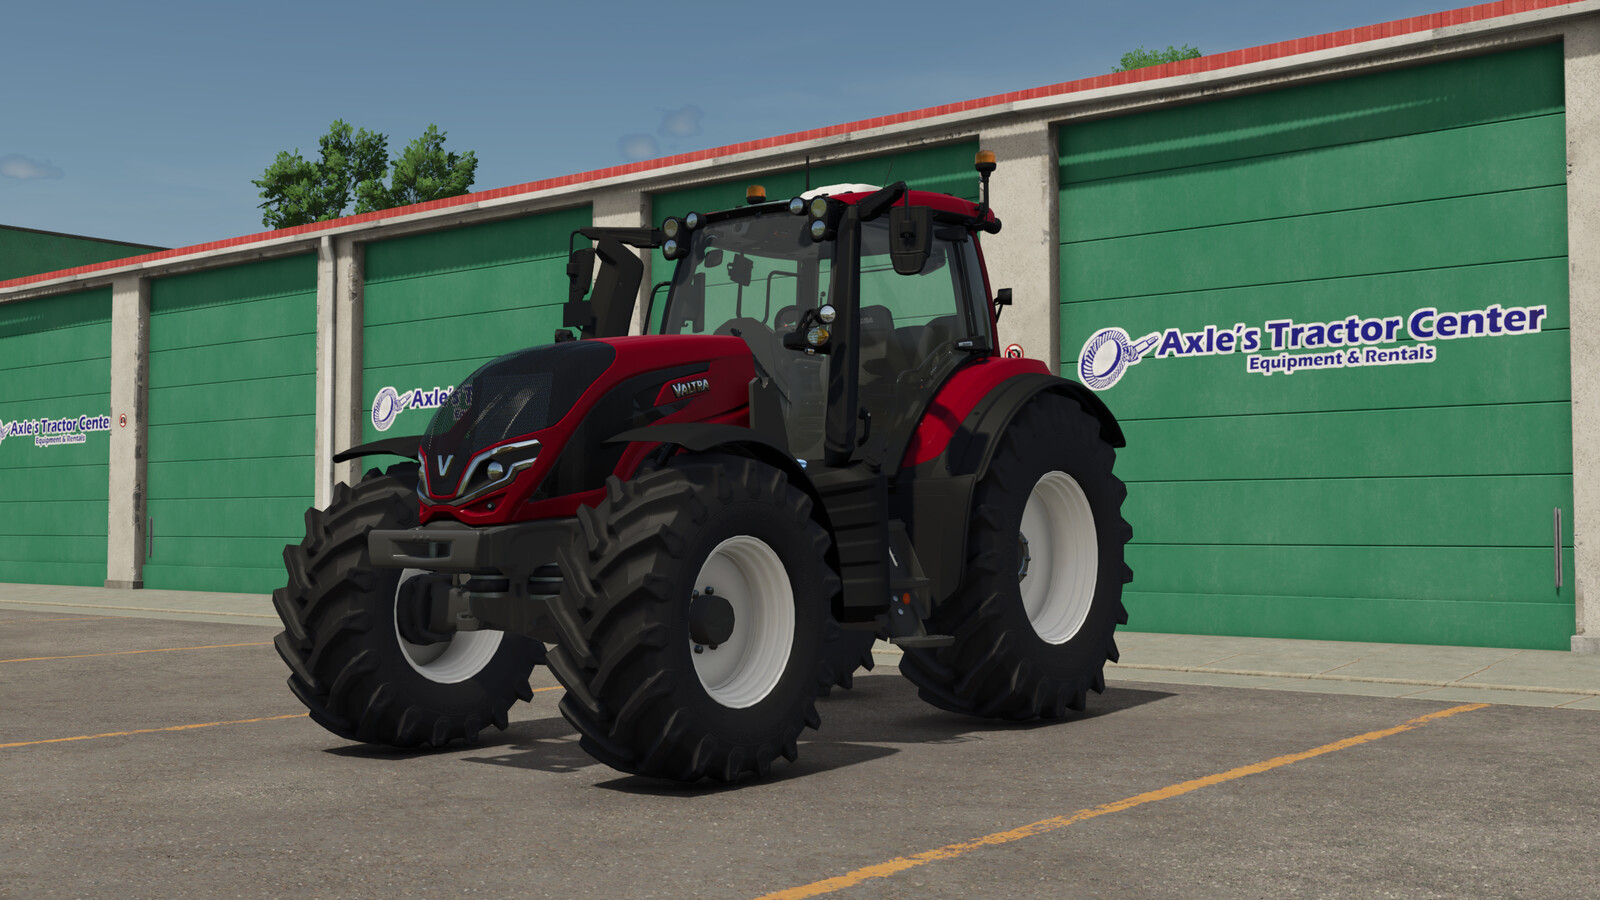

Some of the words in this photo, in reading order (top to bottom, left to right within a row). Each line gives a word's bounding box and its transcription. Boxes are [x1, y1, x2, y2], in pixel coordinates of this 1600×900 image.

[1158, 326, 1258, 355] Axle's
[1268, 318, 1399, 348] Tractor
[1410, 307, 1545, 338] Center
[1250, 352, 1343, 373] Equipment
[1347, 350, 1360, 364] &
[1366, 347, 1434, 363] Rentals
[672, 379, 709, 397] VALTRA
[10, 420, 39, 434] Axle's
[41, 419, 77, 433] Tractor
[36, 436, 61, 445] Equipment
[437, 454, 454, 476] V
